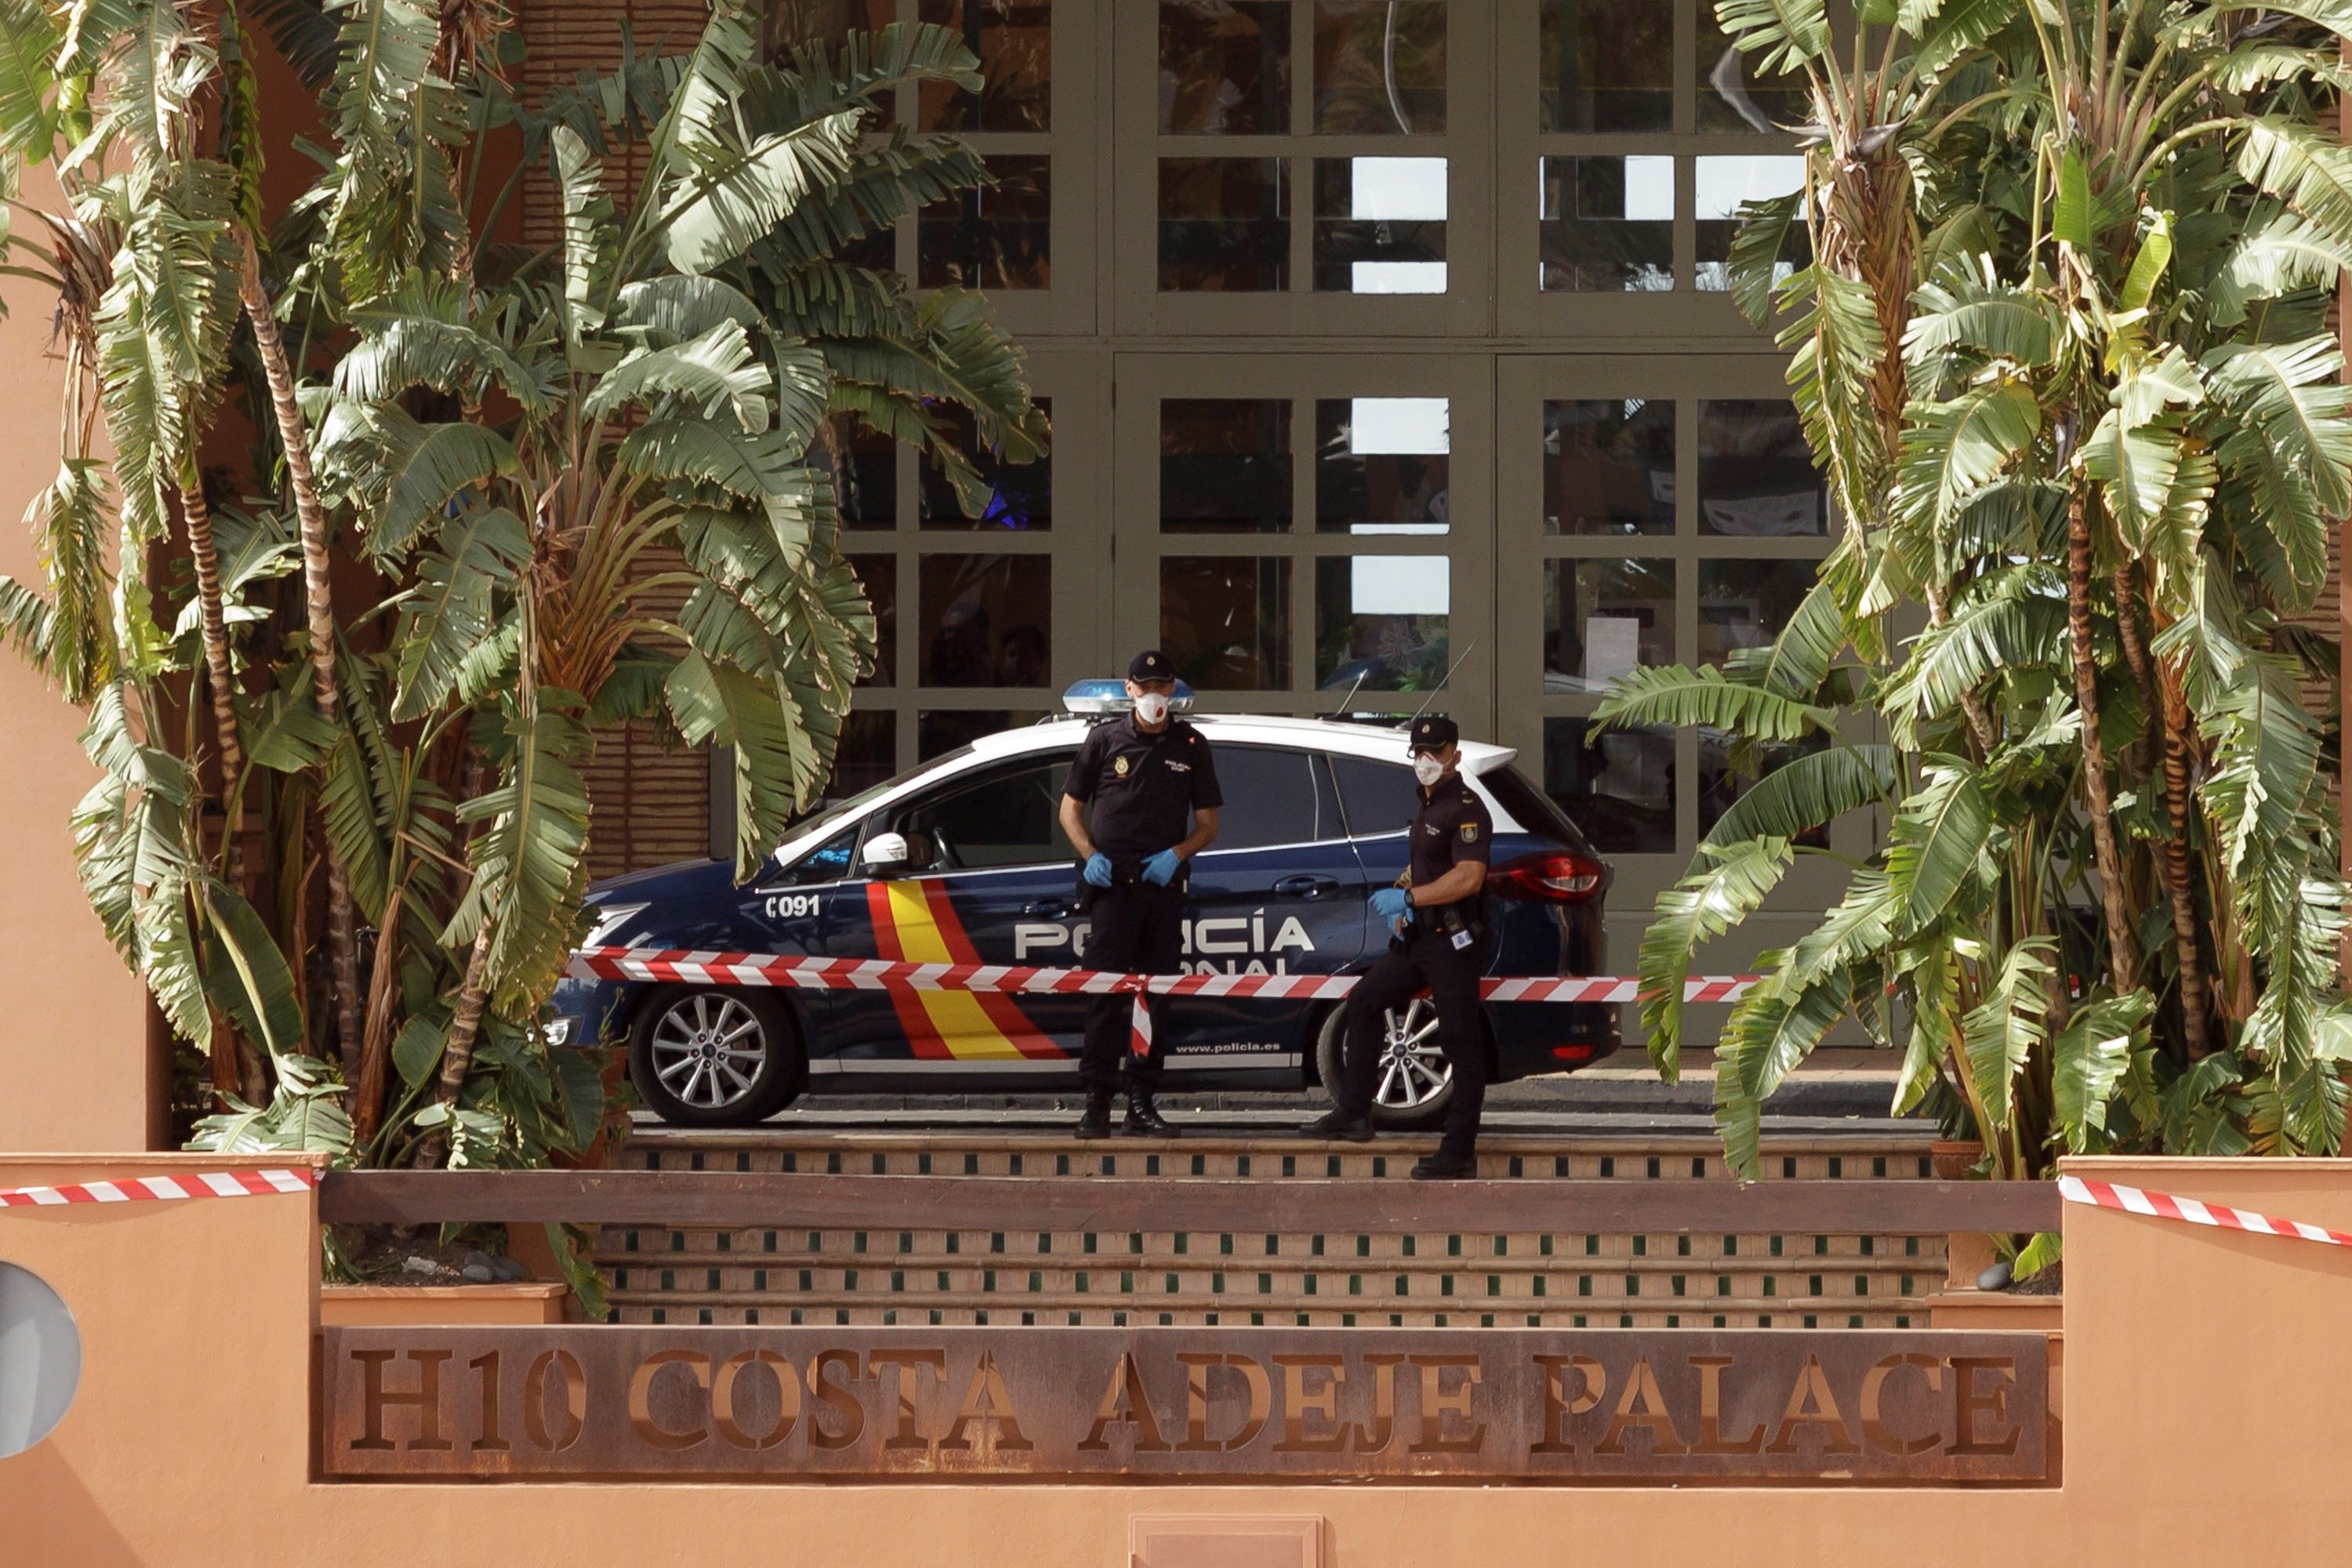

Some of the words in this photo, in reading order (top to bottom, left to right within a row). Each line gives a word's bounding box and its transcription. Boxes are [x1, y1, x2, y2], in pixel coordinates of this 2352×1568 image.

[1014, 907, 1315, 960] PICÍA
[1176, 1042, 1280, 1054] www.policia.es
[350, 1349, 587, 1452] H10
[629, 1348, 1033, 1451] COSTA
[1077, 1351, 1486, 1455] ADEJE
[1530, 1353, 2024, 1455] PALACE
